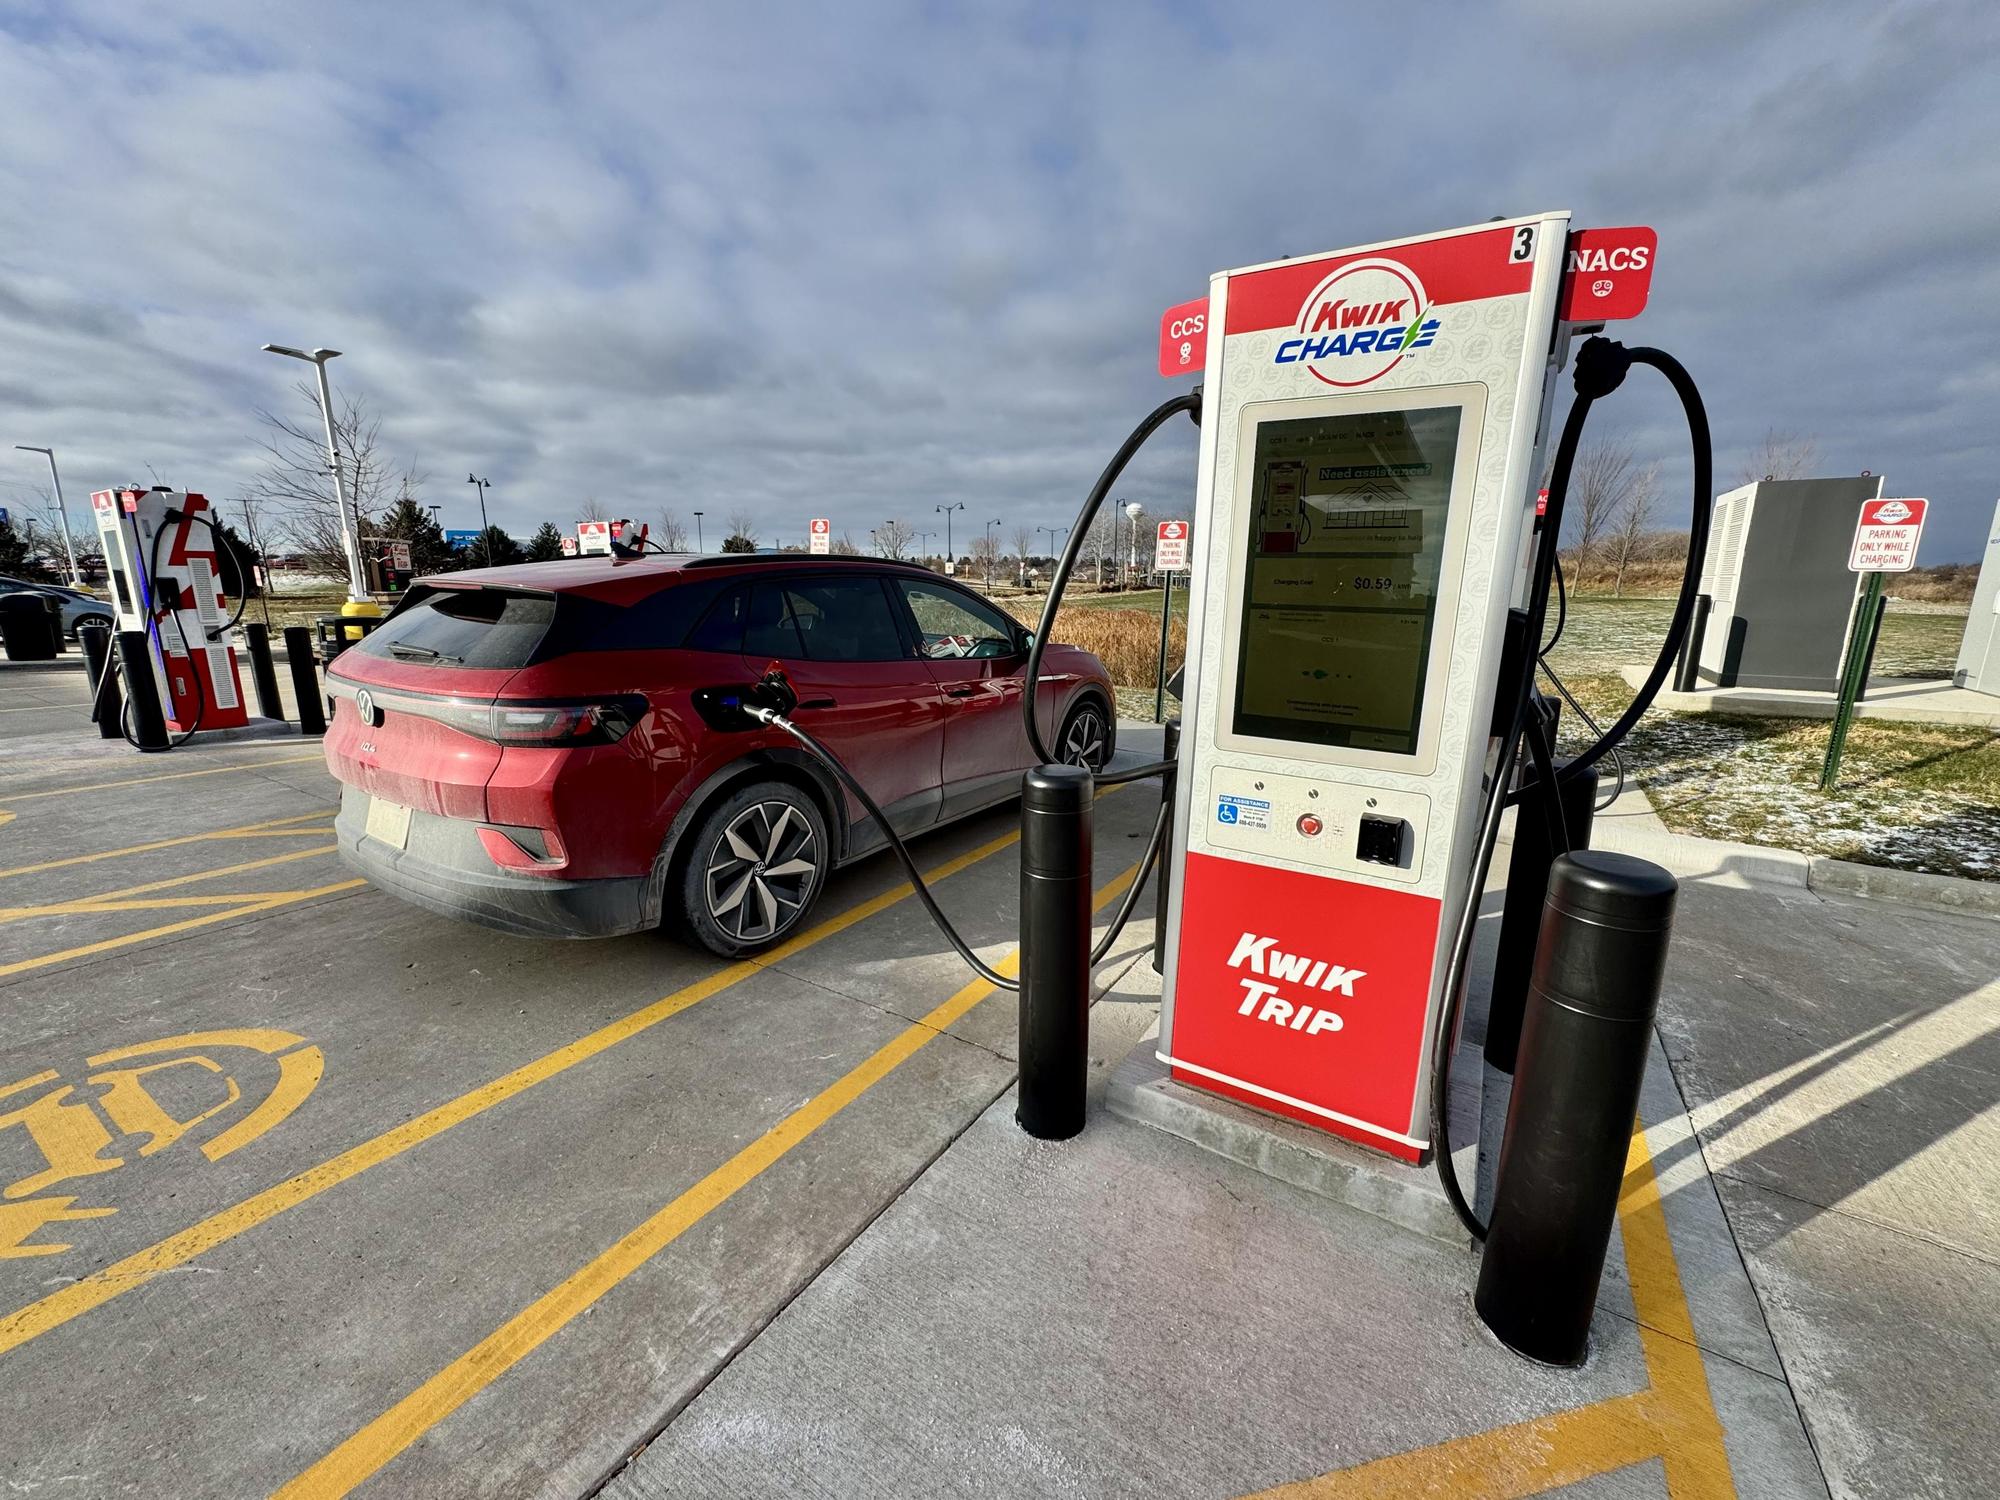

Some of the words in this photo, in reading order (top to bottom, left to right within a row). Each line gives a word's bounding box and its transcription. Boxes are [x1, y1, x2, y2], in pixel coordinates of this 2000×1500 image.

[1514, 227, 1533, 260] 3
[1568, 246, 1649, 272] NACS
[1170, 314, 1205, 339] CCS
[1320, 467, 1352, 480] Need
[1354, 463, 1432, 479] assistance?
[1868, 529, 1907, 539] PARKING
[1860, 542, 1882, 551] ONLY
[1884, 542, 1910, 551] WHILE
[1860, 555, 1904, 564] CHARGING
[1353, 576, 1392, 590] $0.59
[1233, 798, 1269, 808] ASSISTANCE
[1226, 932, 1367, 997] KWIK
[1237, 978, 1344, 1035] TRIP
